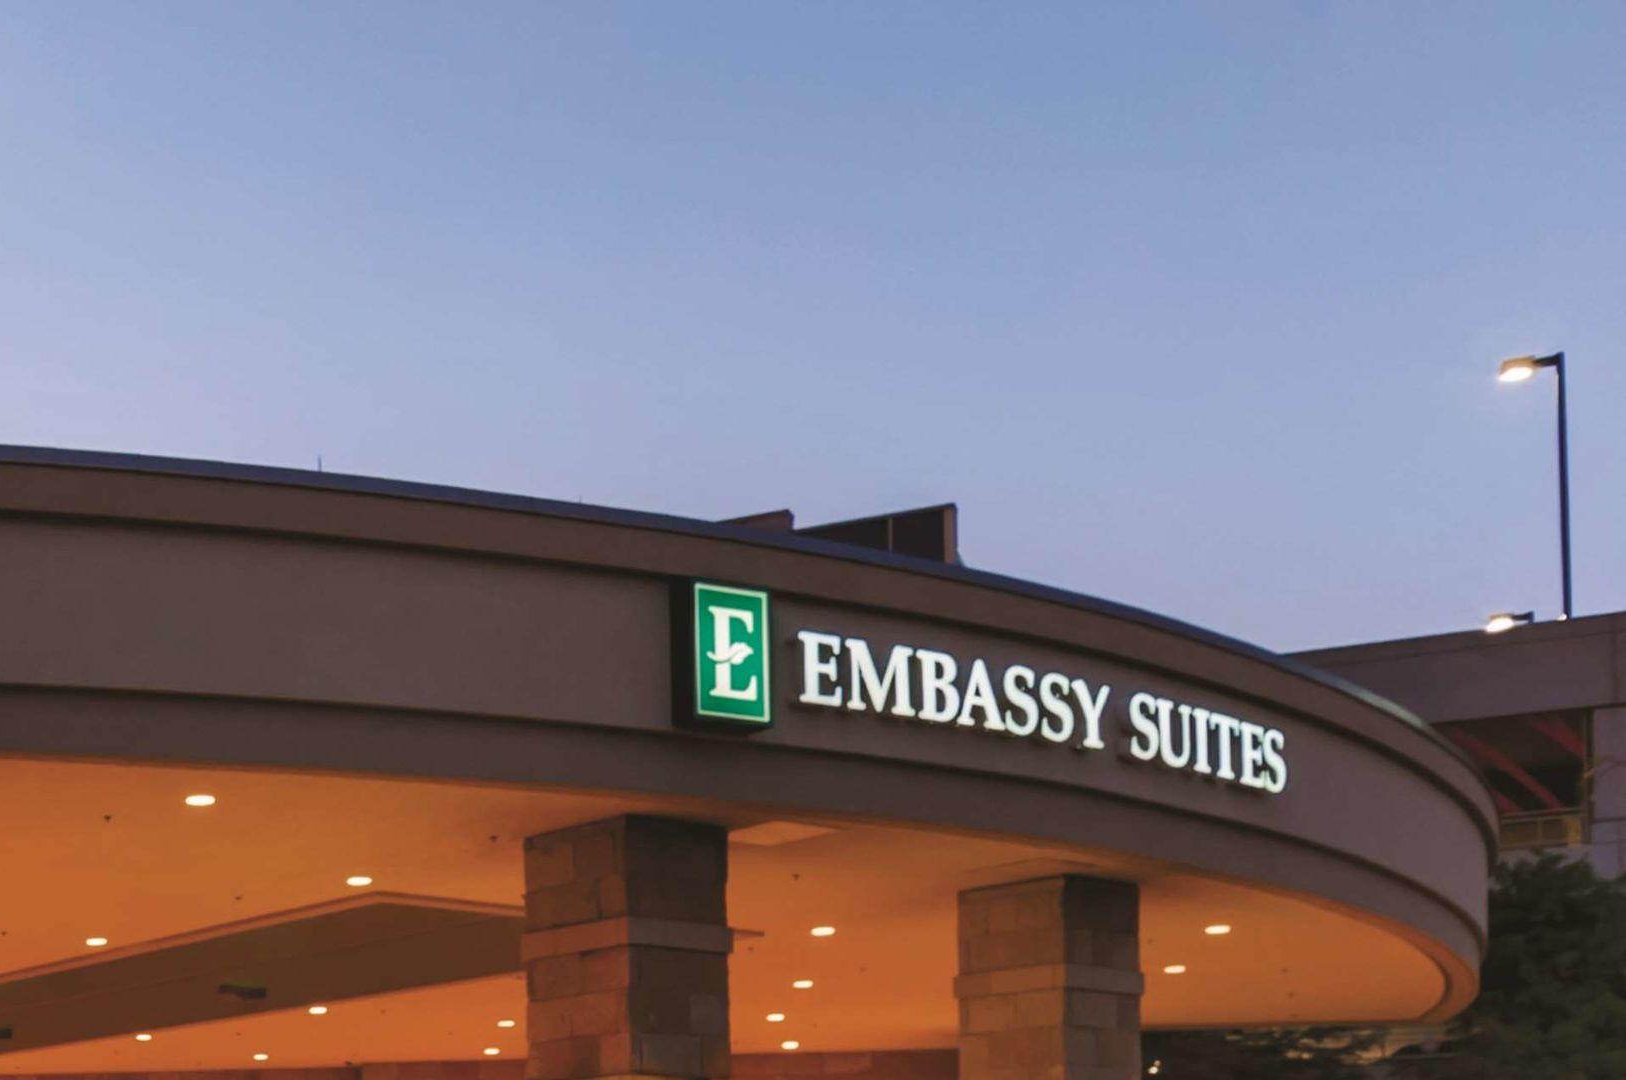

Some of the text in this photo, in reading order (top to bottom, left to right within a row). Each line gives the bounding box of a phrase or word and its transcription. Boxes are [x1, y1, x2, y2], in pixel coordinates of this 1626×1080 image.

[707, 606, 758, 701] E
[797, 630, 1287, 794] EMBASSY SUITES
